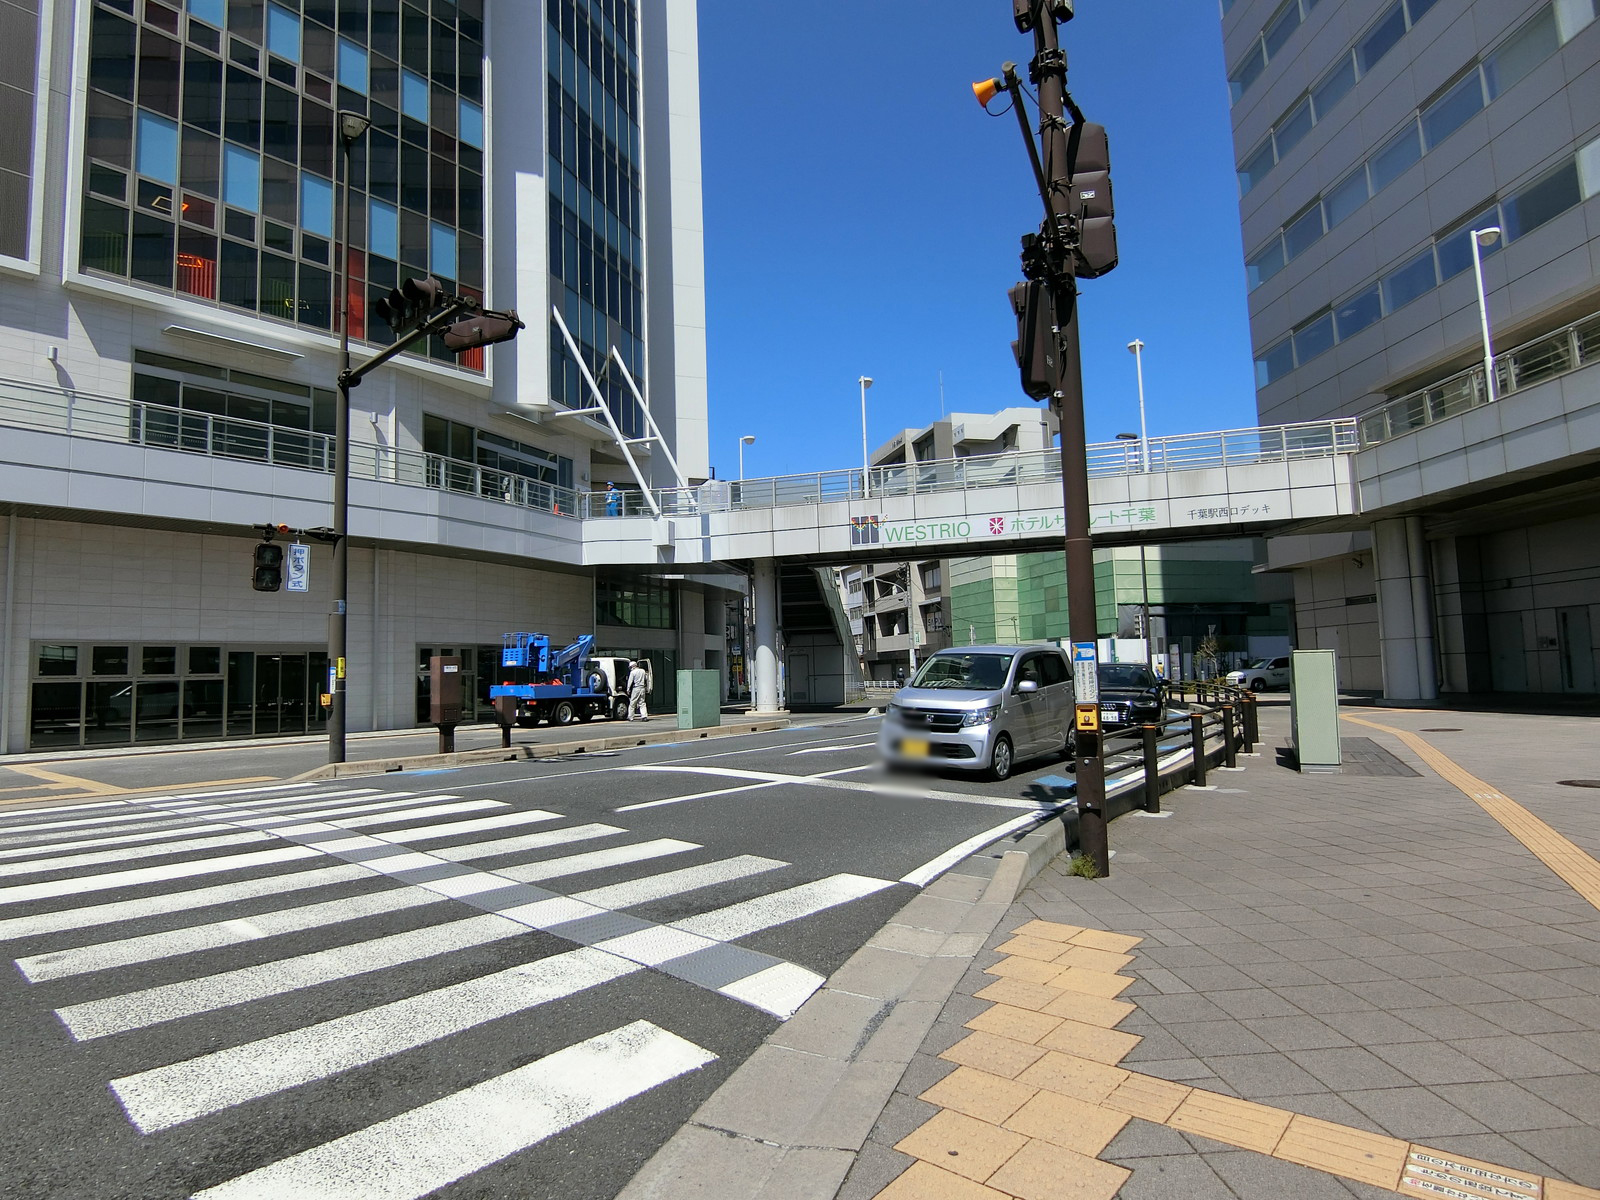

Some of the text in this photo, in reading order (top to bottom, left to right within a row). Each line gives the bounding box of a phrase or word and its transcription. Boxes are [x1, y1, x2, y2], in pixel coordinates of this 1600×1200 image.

[1187, 504, 1271, 520] 千葉駅西口デッキ
[885, 522, 971, 542] WESTRIO
[292, 548, 305, 588] 押ボタン式
